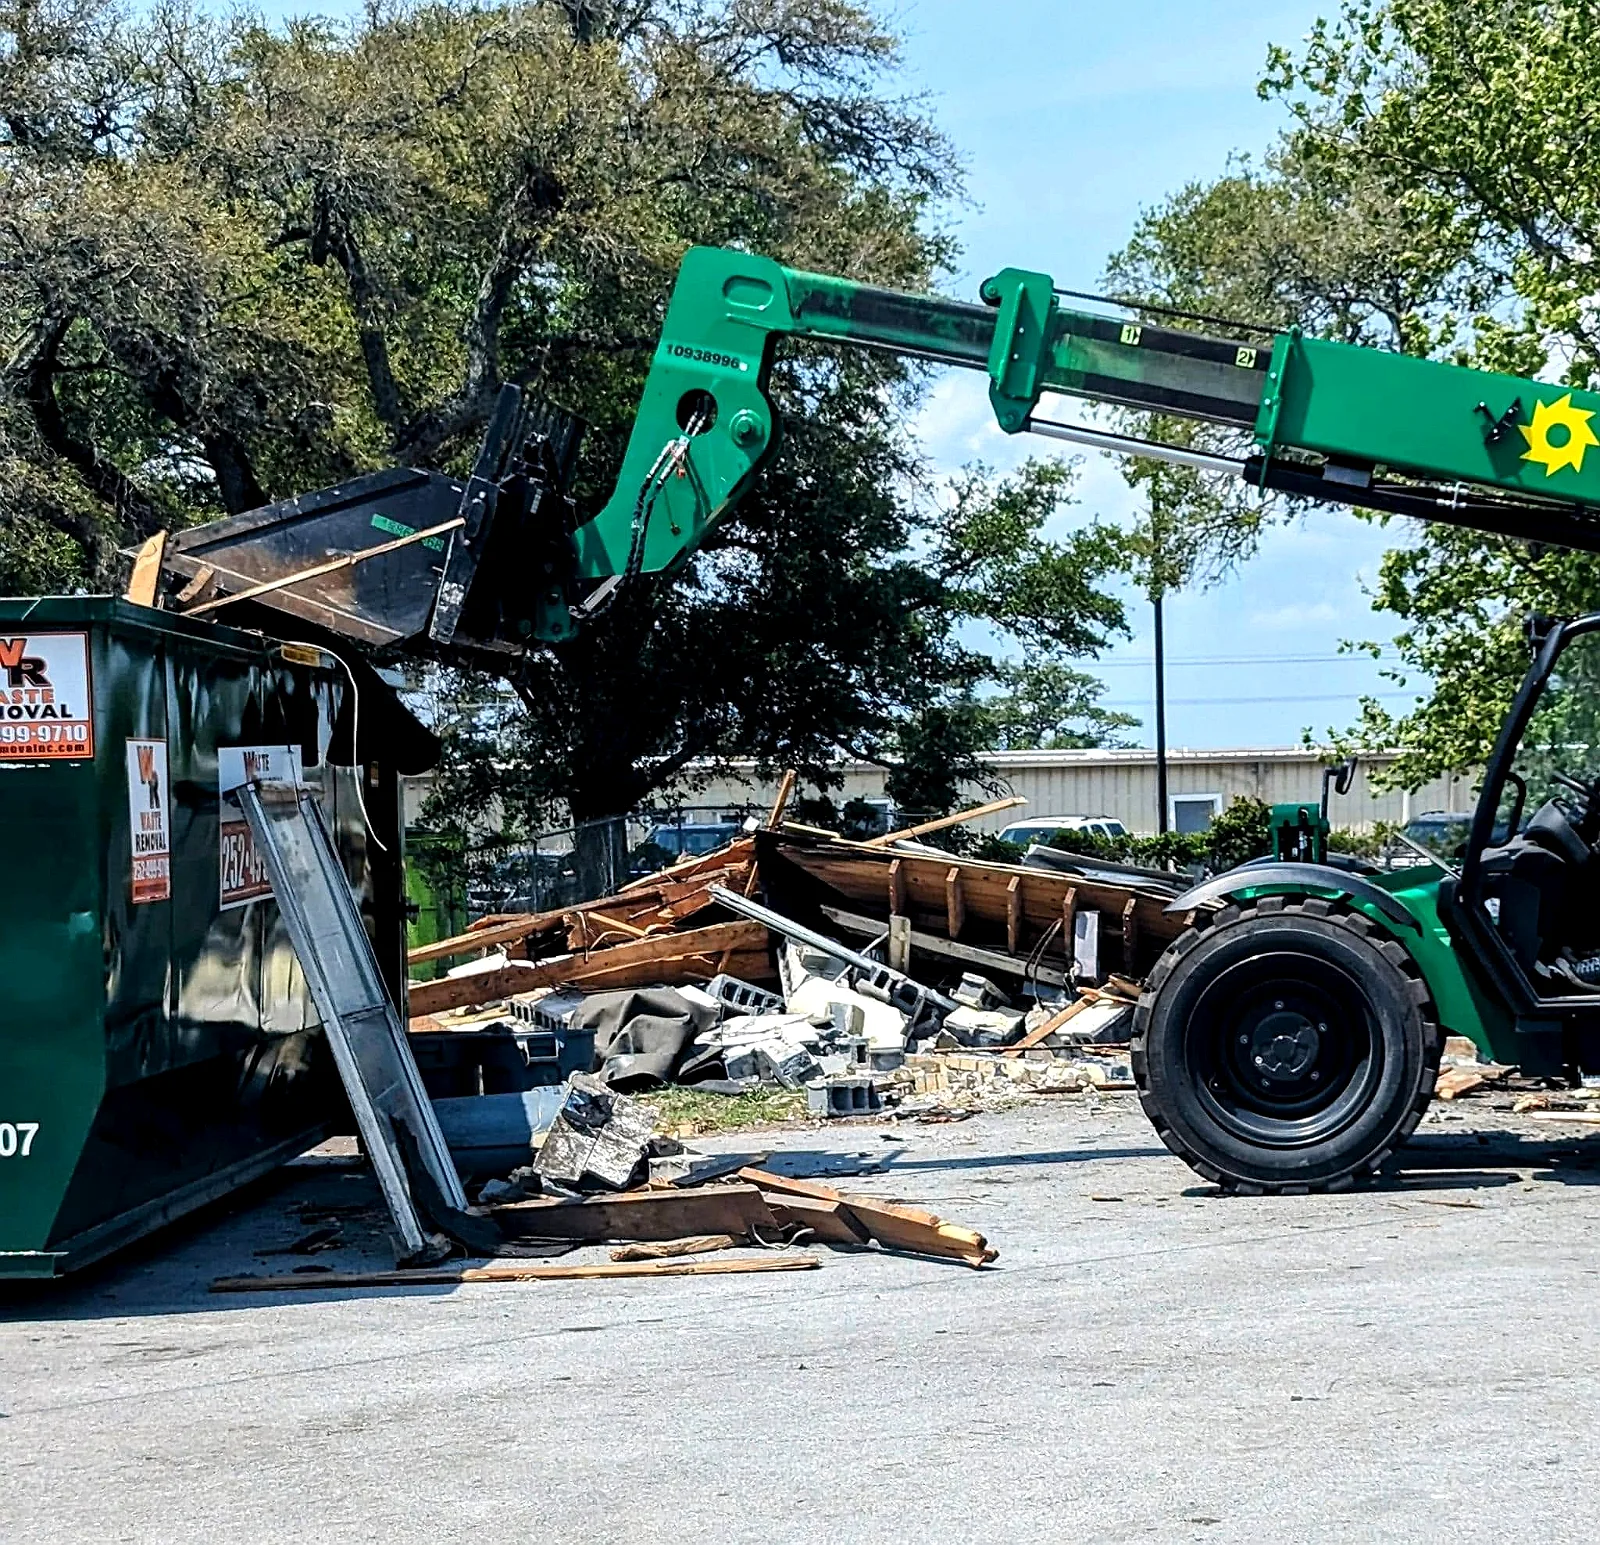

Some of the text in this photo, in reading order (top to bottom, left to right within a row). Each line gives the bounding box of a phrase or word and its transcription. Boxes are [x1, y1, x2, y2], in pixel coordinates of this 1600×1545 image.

[667, 343, 740, 369] 10938996
[1238, 350, 1248, 364] 2
[140, 811, 162, 831] WASTE
[135, 832, 167, 852] REMOVAL
[0, 1122, 39, 1157] 07
